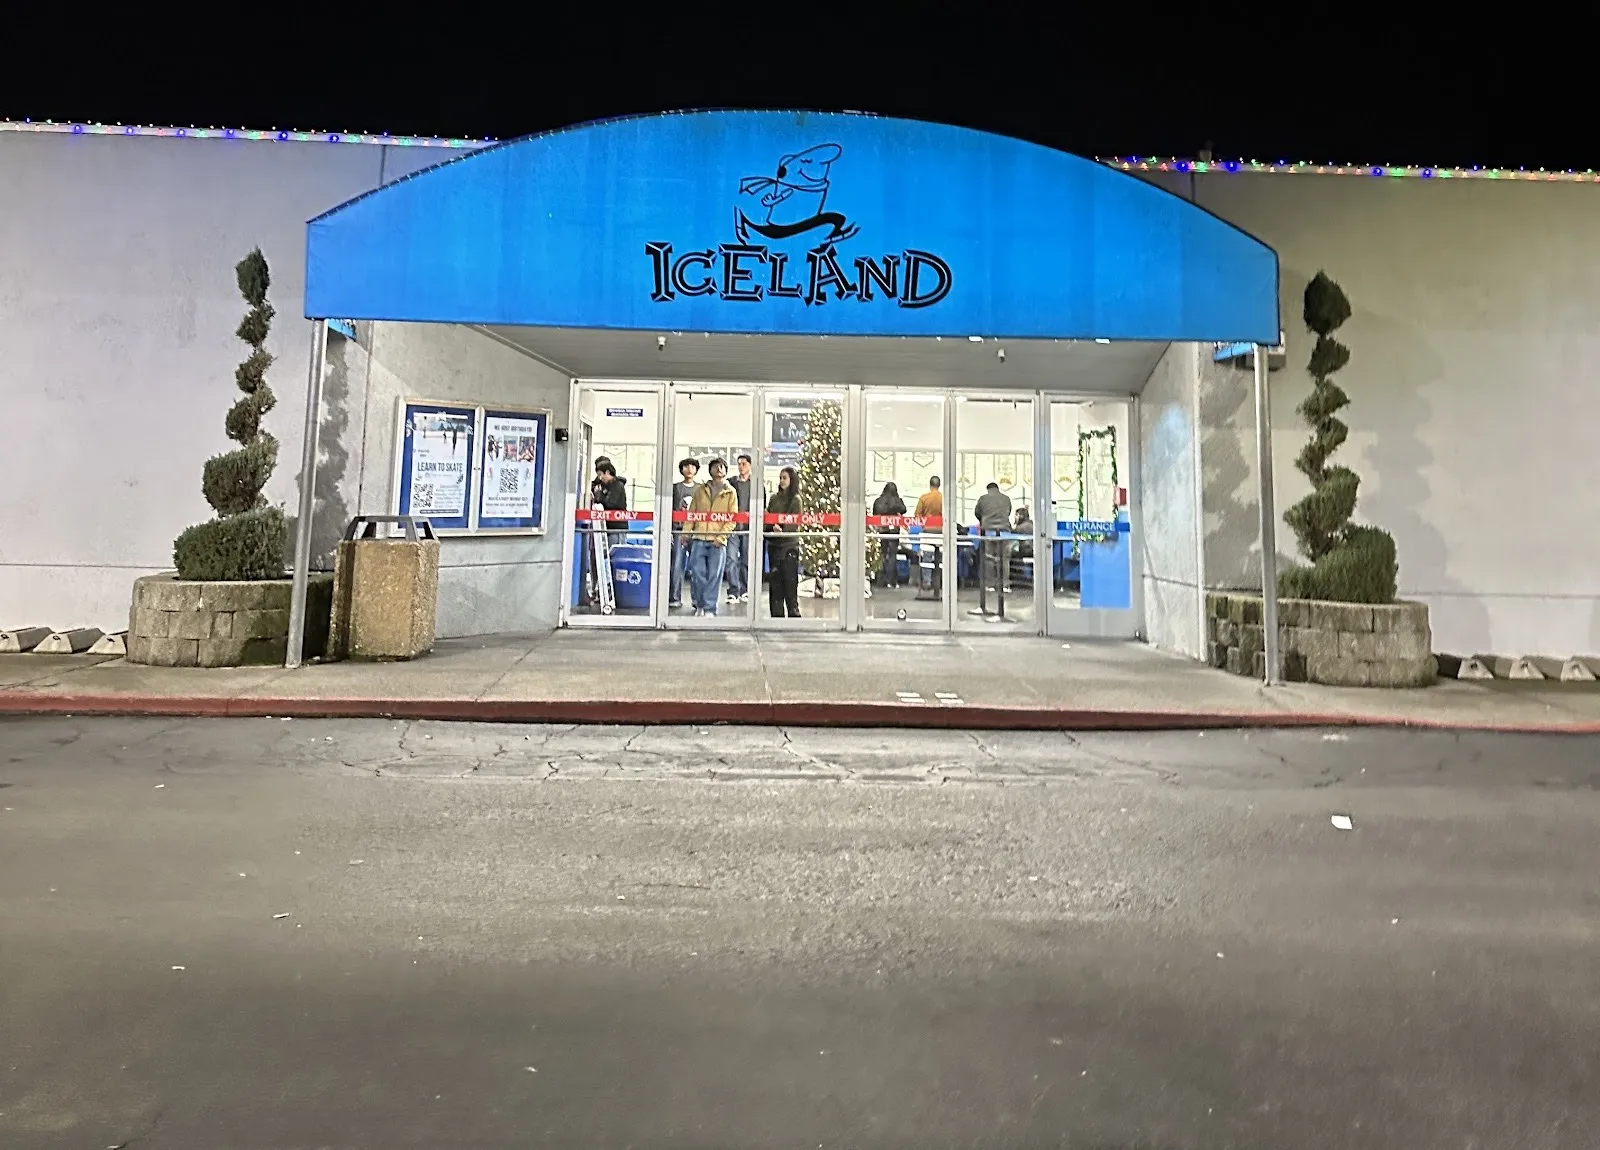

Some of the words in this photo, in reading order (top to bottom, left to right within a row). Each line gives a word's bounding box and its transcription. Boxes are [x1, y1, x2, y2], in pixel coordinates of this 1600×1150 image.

[644, 241, 953, 309] ICELAND
[417, 462, 437, 472] LEARN
[438, 462, 445, 472] TO
[446, 463, 463, 472] SKATE
[590, 510, 611, 519] EXIT
[614, 511, 638, 520] ONLY
[687, 512, 707, 521] EXIT
[710, 512, 734, 521] ONLY
[778, 514, 798, 523] EXIT
[802, 514, 825, 524] ONLY
[880, 516, 901, 526] EXIT
[904, 516, 927, 526] ONLY
[1065, 522, 1115, 531] ENTRANCE
